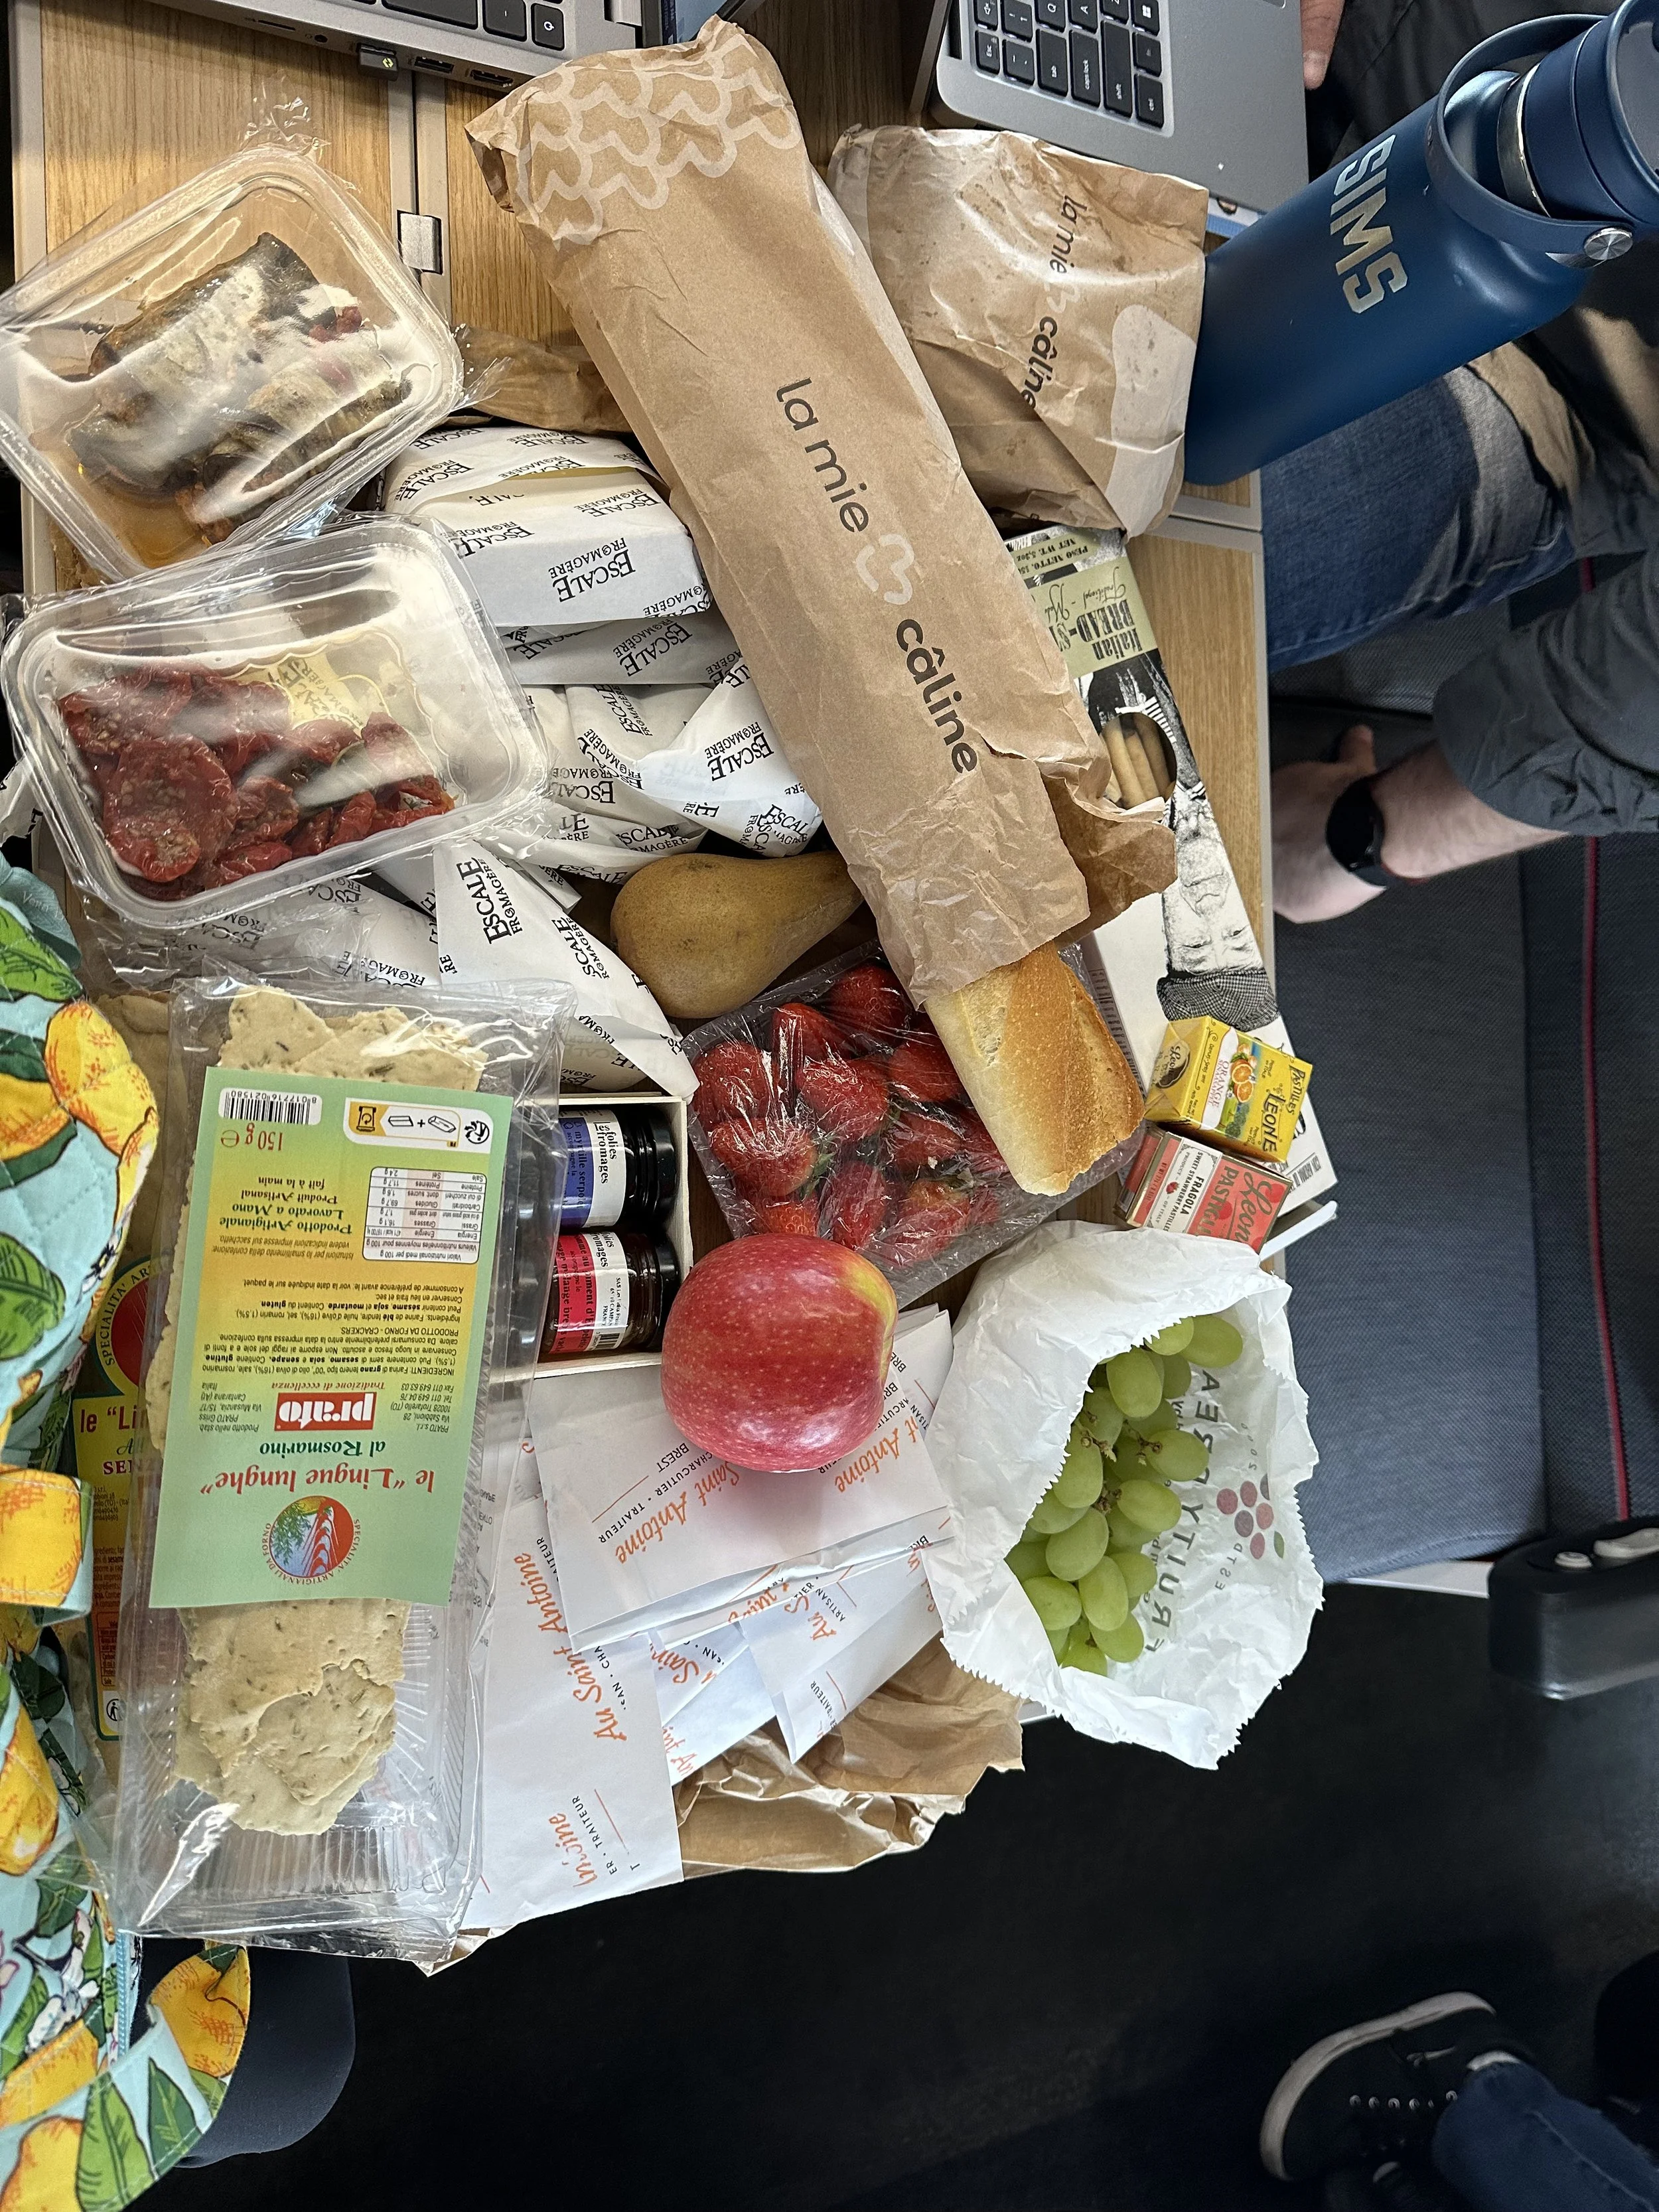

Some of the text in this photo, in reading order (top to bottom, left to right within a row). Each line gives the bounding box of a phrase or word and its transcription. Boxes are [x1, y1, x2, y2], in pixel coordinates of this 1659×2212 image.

[1047, 3, 1056, 13] Q
[1080, 5, 1089, 14] A
[1330, 135, 1408, 314] SIMS
[1020, 194, 1088, 409] la mie câline
[514, 434, 590, 448] ESCALE
[399, 463, 474, 500] ESCALE
[581, 492, 662, 518] ESCALE
[548, 538, 627, 579] FROMAGÈRE
[552, 548, 636, 603] ESCALE
[776, 377, 979, 774] la mie câline
[619, 621, 693, 678] ESCALE
[1091, 628, 1143, 661] Italian
[704, 721, 762, 759] FROMAGÈRE
[707, 732, 775, 782] ESCALE
[457, 856, 512, 945] ESCALE
[478, 857, 524, 936] FROMAGÈRE
[551, 916, 598, 980] SCALE
[230, 1088, 267, 1101] 021580
[1212, 1060, 1229, 1109] ORANGE
[1287, 1063, 1306, 1116] PASTILLES
[270, 1092, 307, 1104] 017716
[1262, 1088, 1287, 1153] LEONE
[243, 1121, 284, 1151] 150 g
[607, 1131, 619, 1160] folies
[597, 1132, 610, 1185] fromages
[1190, 1151, 1203, 1173] SWEET
[257, 1176, 325, 1191] fait à la main
[1176, 1171, 1194, 1210] STRAWBERRY
[1180, 1175, 1204, 1215] FRAGOLA
[231, 1203, 273, 1216] Mano
[240, 1189, 338, 1205] Produit Artisanal
[1234, 1172, 1273, 1244] Leon
[219, 1216, 352, 1235] Prodotto Artigianale
[287, 1207, 344, 1220] Lavorato
[340, 1326, 459, 1337] PRODOTTO DA FORNO CRACKERS.
[201, 1364, 236, 1372] rosmarino
[236, 1364, 252, 1374] sale,
[253, 1364, 275, 1374] (16%),
[275, 1366, 291, 1374] oliva
[291, 1366, 298, 1374] di
[298, 1366, 311, 1374] olio
[326, 1364, 338, 1374] tipo
[338, 1365, 359, 1374] tenero
[381, 1365, 388, 1374] di
[388, 1365, 409, 1374] Farina
[200, 1381, 218, 1392] Italia
[270, 1380, 386, 1391] Tradizione di eccellenza
[399, 1392, 430, 1402] 649.04.76
[400, 1382, 455, 1394] Fax 011 649.63.03
[198, 1412, 239, 1423] PRATO Griss
[277, 1388, 375, 1430] prato
[390, 1400, 451, 1413] 10028 Trofarello (TO)
[402, 1411, 450, 1424] Via Sabbioni, 28
[910, 1404, 929, 1431] TISAN
[80, 1408, 98, 1434] le
[198, 1423, 259, 1433] Prodotto nello stab.
[259, 1439, 386, 1459] al Rosmarino
[656, 1442, 690, 1473] BREST
[834, 1427, 901, 1493] Antoine
[200, 1463, 435, 1495] le “Lingue lunghe”
[598, 1451, 713, 1544] CHARCUTIER TRAITEUR
[258, 1521, 273, 1556] FORNO
[614, 1491, 687, 1564] Antoine
[264, 1556, 277, 1571] DA
[273, 1568, 336, 1585] ARTIGIANALI
[513, 1552, 569, 1634] Antoine
[815, 1586, 846, 1623] ARTISAN
[806, 1611, 838, 1641] Au
[593, 1707, 628, 1741] Au
[571, 1795, 603, 1849] TRAITEUR
